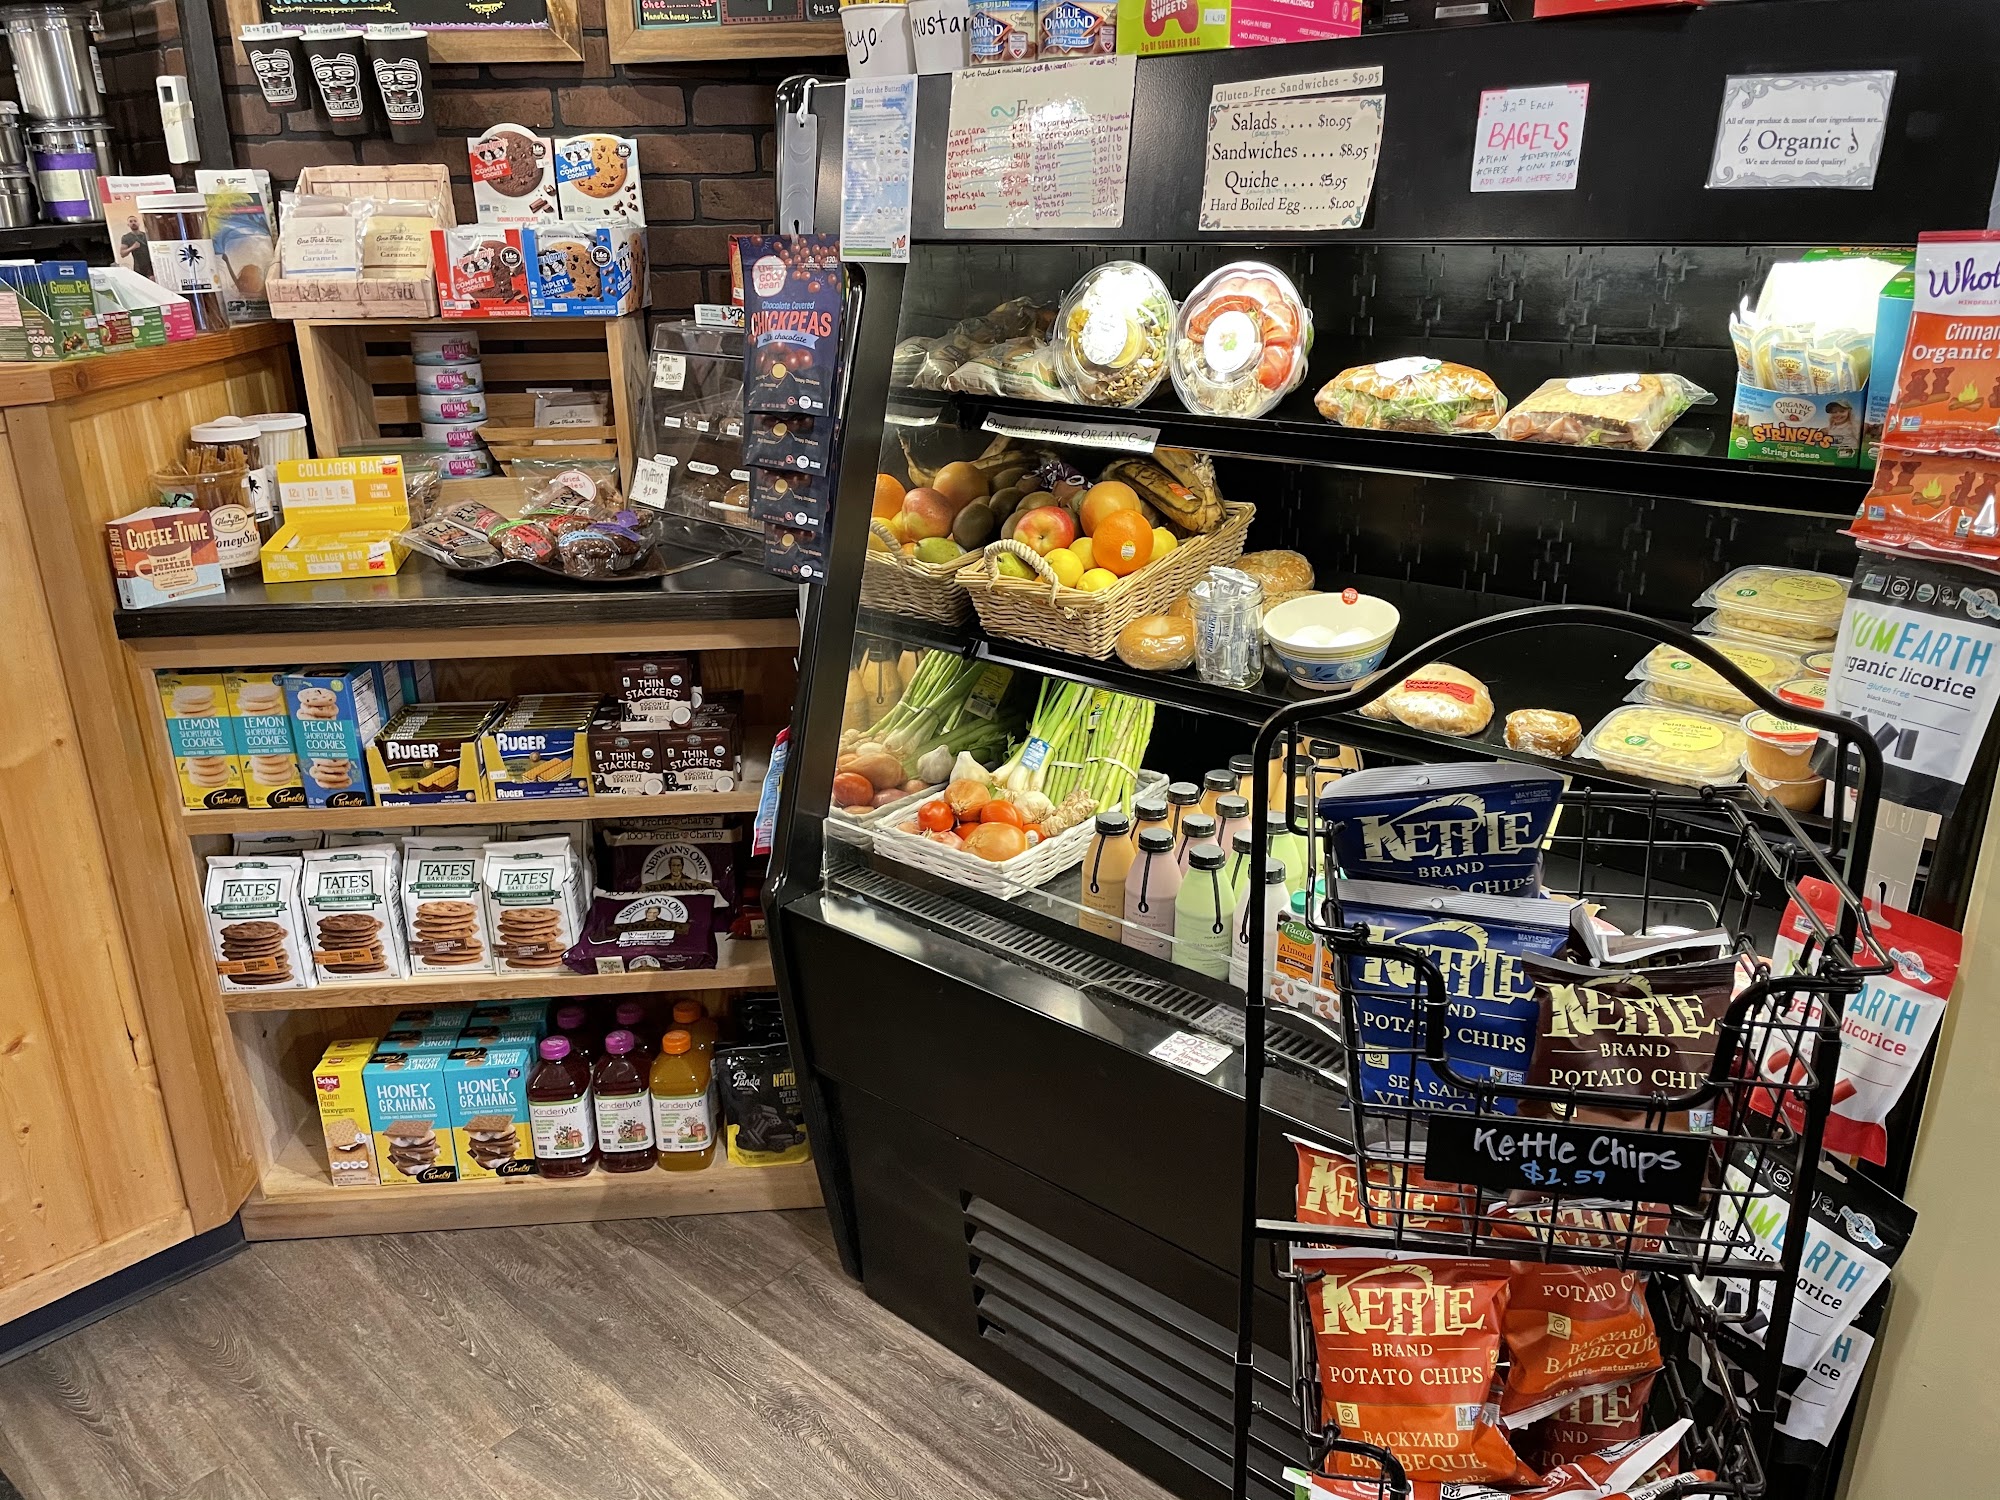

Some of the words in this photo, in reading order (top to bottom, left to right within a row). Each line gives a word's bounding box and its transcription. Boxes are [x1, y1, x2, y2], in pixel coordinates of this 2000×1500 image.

[813, 4, 834, 14] $4.25
[1055, 7, 1081, 20] BLUE
[1151, 0, 1188, 23] SWEETS
[1045, 16, 1095, 30] DIAMOND
[1158, 40, 1175, 49] SUGAR
[1177, 39, 1186, 48] PER
[1188, 38, 1200, 46] BAG
[852, 86, 864, 94] Look
[875, 85, 883, 93] the
[884, 83, 910, 93] Butterfly!
[1215, 86, 1276, 102] Gluten-Free
[1280, 77, 1339, 93] Sandwiches
[1352, 71, 1380, 85] $9.95
[328, 100, 359, 111] HERITAGE
[387, 104, 420, 114] HERITAGE
[1531, 101, 1554, 110] EACH
[1231, 111, 1277, 131] Salads
[1318, 114, 1352, 131] $10.95
[1757, 118, 1782, 126] produce
[1809, 116, 1816, 124] of
[1829, 116, 1865, 124] ingredients
[949, 136, 972, 148] navel
[1488, 122, 1569, 150] BAGELS
[1036, 141, 1064, 152] shallots
[1757, 129, 1840, 157] Organic
[948, 144, 987, 160] grapefruit
[1212, 140, 1298, 160] Sandwiches
[1339, 143, 1369, 160] $8.95
[1821, 157, 1846, 167] quality!
[474, 163, 508, 176] COMPLETE
[559, 163, 593, 176] COMPLETE
[1225, 169, 1279, 195] Quiche
[1319, 173, 1348, 190] $5.95
[1210, 198, 1238, 211] Hard
[1240, 197, 1274, 211] Boiled
[1278, 197, 1300, 215] Egg
[1328, 197, 1355, 210] $1.00
[50, 280, 75, 294] Greens
[76, 281, 91, 293] Pak
[462, 283, 485, 293] COOKIE
[759, 282, 781, 290] bean
[762, 301, 791, 310] Chocolate
[792, 301, 815, 310] Covered
[751, 311, 832, 337] CHICKPEAS
[774, 333, 807, 344] chocolate
[662, 364, 672, 372] MINI
[437, 375, 464, 384] DOLMAS
[442, 403, 468, 412] DOLMAS
[1775, 401, 1814, 412] ORGANIC
[1779, 408, 1810, 418] VALLEY
[986, 415, 1005, 431] Our
[1006, 420, 1040, 436] produce
[1040, 425, 1048, 435] is
[1049, 428, 1079, 440] always
[1081, 427, 1138, 444] ORGANIC
[1761, 447, 1788, 458] String
[1790, 450, 1820, 459] Cheese
[656, 456, 676, 464] CHOCOLATE
[690, 463, 704, 471] ALMOND
[126, 527, 173, 551] COFFEE
[173, 521, 210, 542] TIME
[304, 553, 344, 563] COLLAGEN
[347, 551, 363, 560] BAR
[153, 560, 191, 572] PUZZLES
[638, 679, 664, 688] THIN
[1866, 682, 1891, 695] gluten
[1892, 686, 1911, 698] free
[626, 688, 679, 699] STACKERS
[1882, 698, 1901, 707] licorice
[178, 719, 220, 731] LEMON
[244, 716, 285, 728] LEMON
[303, 721, 343, 732] PECAN
[180, 729, 222, 738] SHORTBREAD
[181, 738, 224, 747] COOKIES
[246, 736, 289, 746] COOKIES
[496, 733, 546, 751] RUGER
[387, 741, 439, 760] RUGER
[610, 752, 636, 761] THIN
[598, 761, 650, 772] STACKERS
[650, 830, 680, 840] Profits
[689, 828, 723, 840] Charity
[1353, 793, 1543, 863] KETTLE
[1418, 861, 1484, 878] BRAND
[323, 875, 369, 889] TATE'S
[227, 883, 276, 896] TATE'S
[619, 898, 669, 920] NEWMAN'S
[668, 901, 684, 919] OWN
[1284, 922, 1311, 940] Pacific
[1280, 944, 1312, 961] Almond
[1600, 1043, 1671, 1058] BRAND
[316, 1076, 339, 1086] Schär
[457, 1078, 512, 1094] HONEY
[733, 1070, 761, 1093] Panda
[376, 1083, 431, 1099] HONEY
[319, 1094, 340, 1102] Gluten
[459, 1092, 517, 1108] GRAHAMS
[379, 1097, 436, 1113] GRAHAMS
[533, 1105, 578, 1118] Kinderlyte
[1474, 1128, 1577, 1164] Kettle
[1588, 1136, 1682, 1183] Chips
[1318, 1264, 1488, 1337] KETTLE
[1544, 1332, 1656, 1375] BARBEQUE
[1329, 1366, 1413, 1386] POTATO
[1420, 1366, 1484, 1385] CHIPS
[1363, 1430, 1459, 1449] BACKYARD
